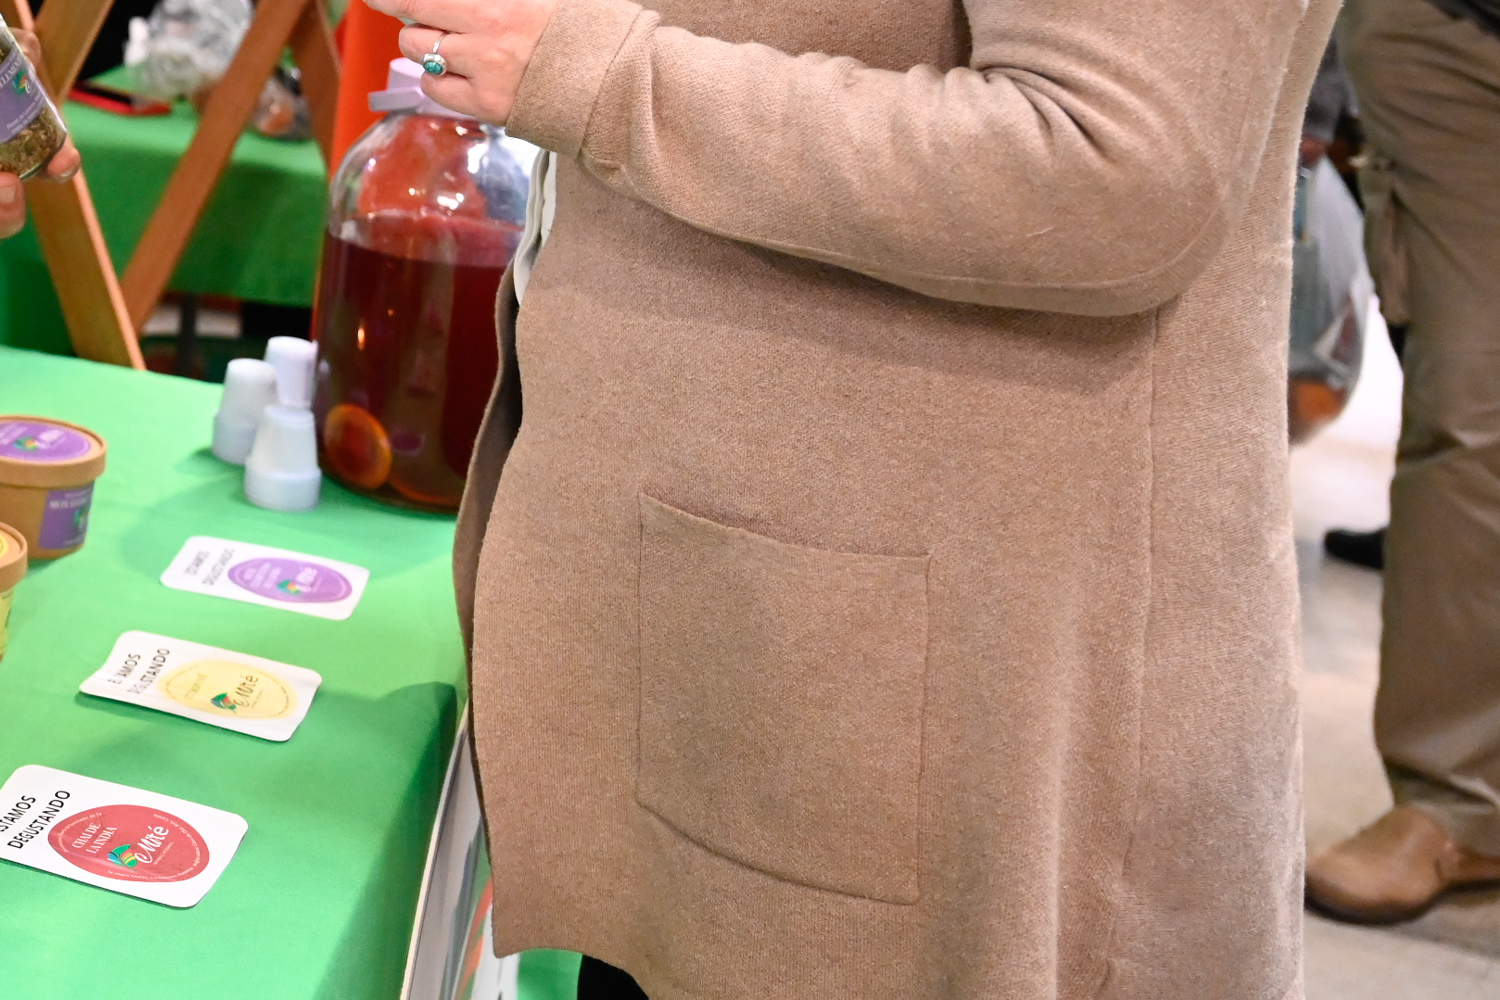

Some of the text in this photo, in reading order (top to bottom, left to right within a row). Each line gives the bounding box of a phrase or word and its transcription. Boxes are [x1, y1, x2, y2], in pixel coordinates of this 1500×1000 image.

[7, 790, 71, 849] DEGUSTANDO
[71, 829, 94, 849] CHAI
[86, 826, 117, 854] LA INDIA
[134, 825, 169, 864] Mité
